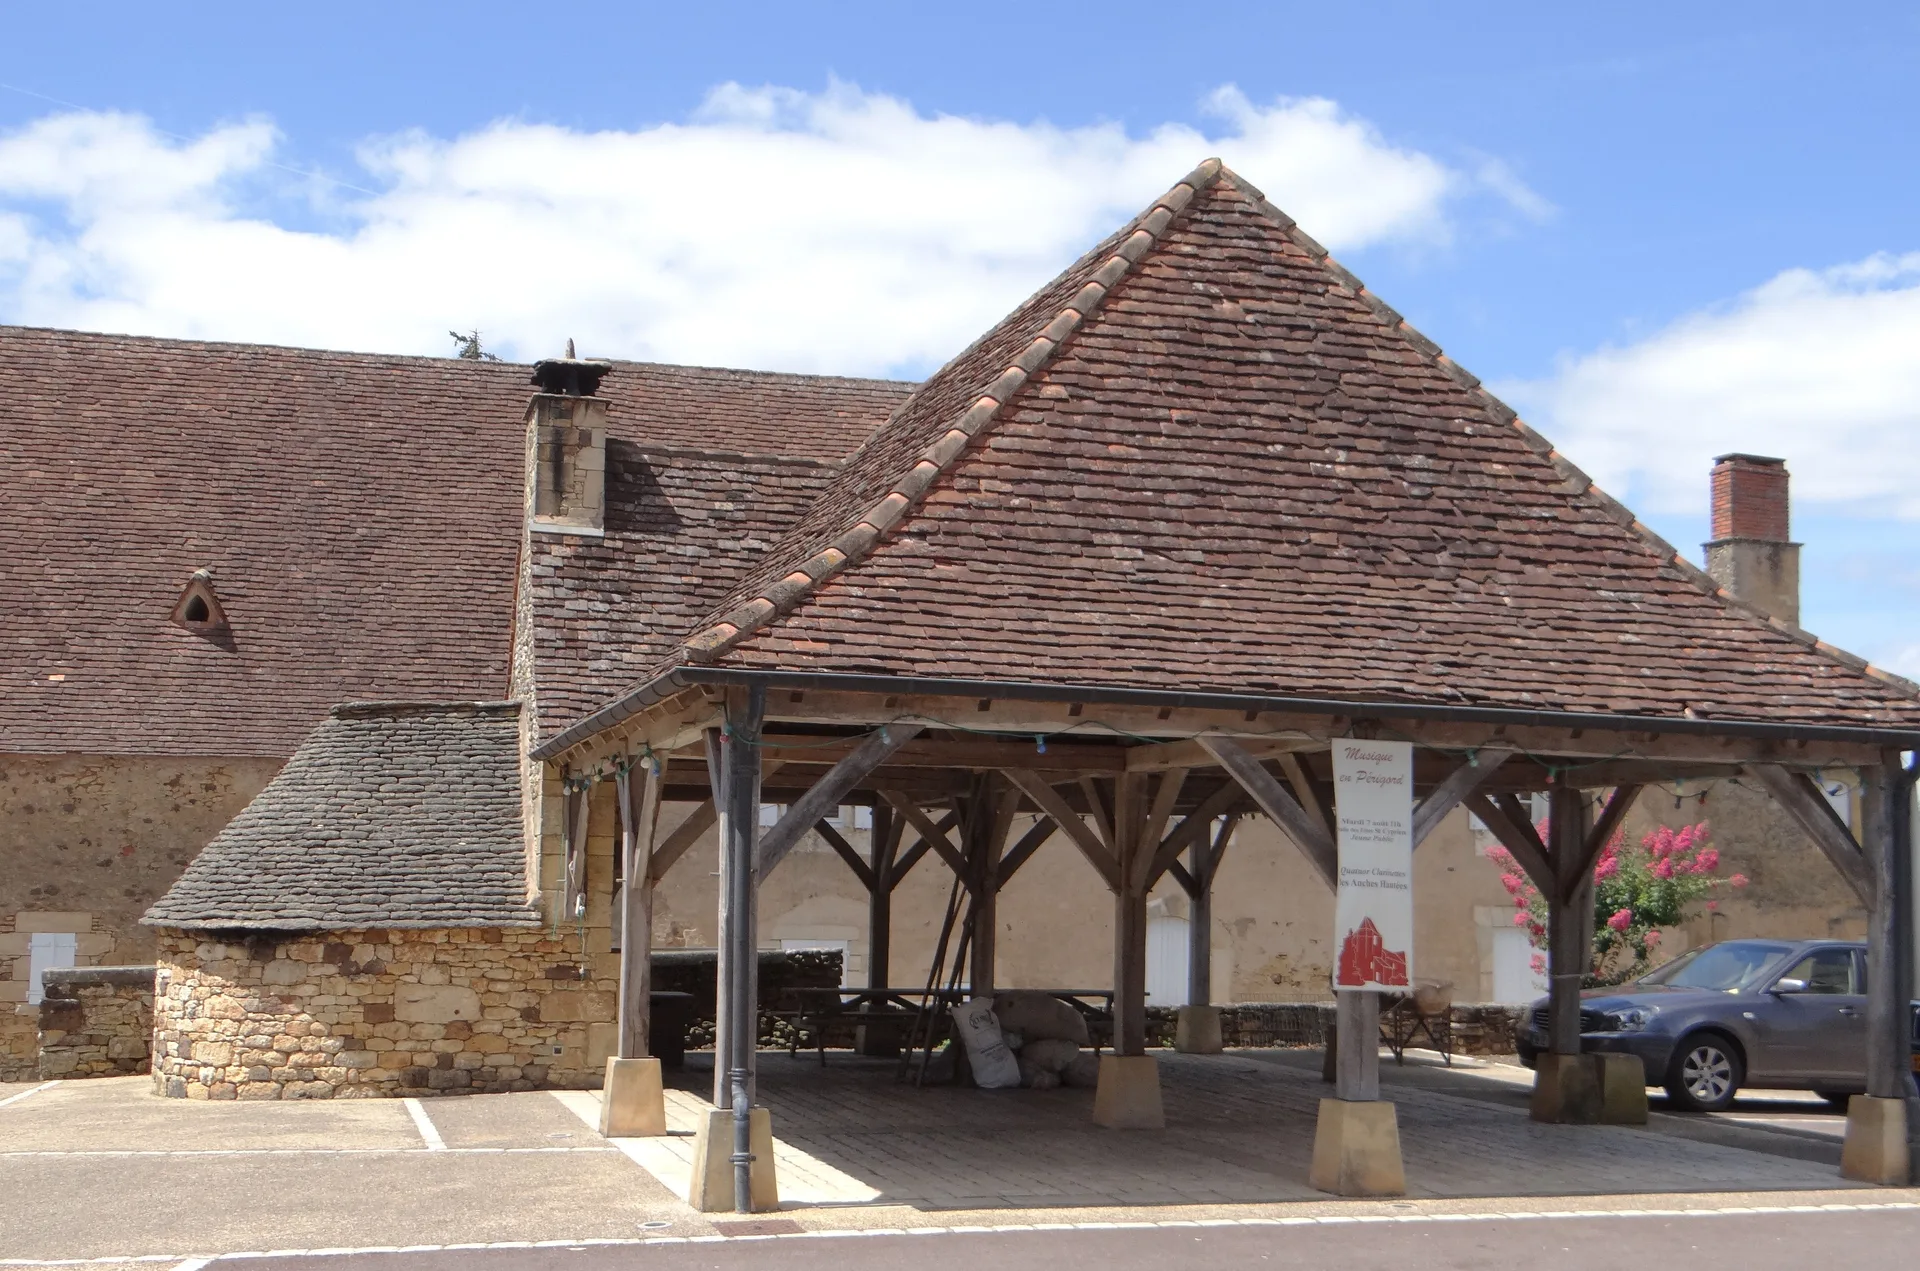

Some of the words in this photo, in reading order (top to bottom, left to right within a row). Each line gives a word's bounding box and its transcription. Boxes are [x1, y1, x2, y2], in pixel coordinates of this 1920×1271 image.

[1344, 747, 1393, 765] Musique
[1340, 774, 1351, 782] en
[1356, 770, 1404, 787] Périgord
[1340, 866, 1370, 876] Quatuor
[1351, 879, 1378, 888] Anches
